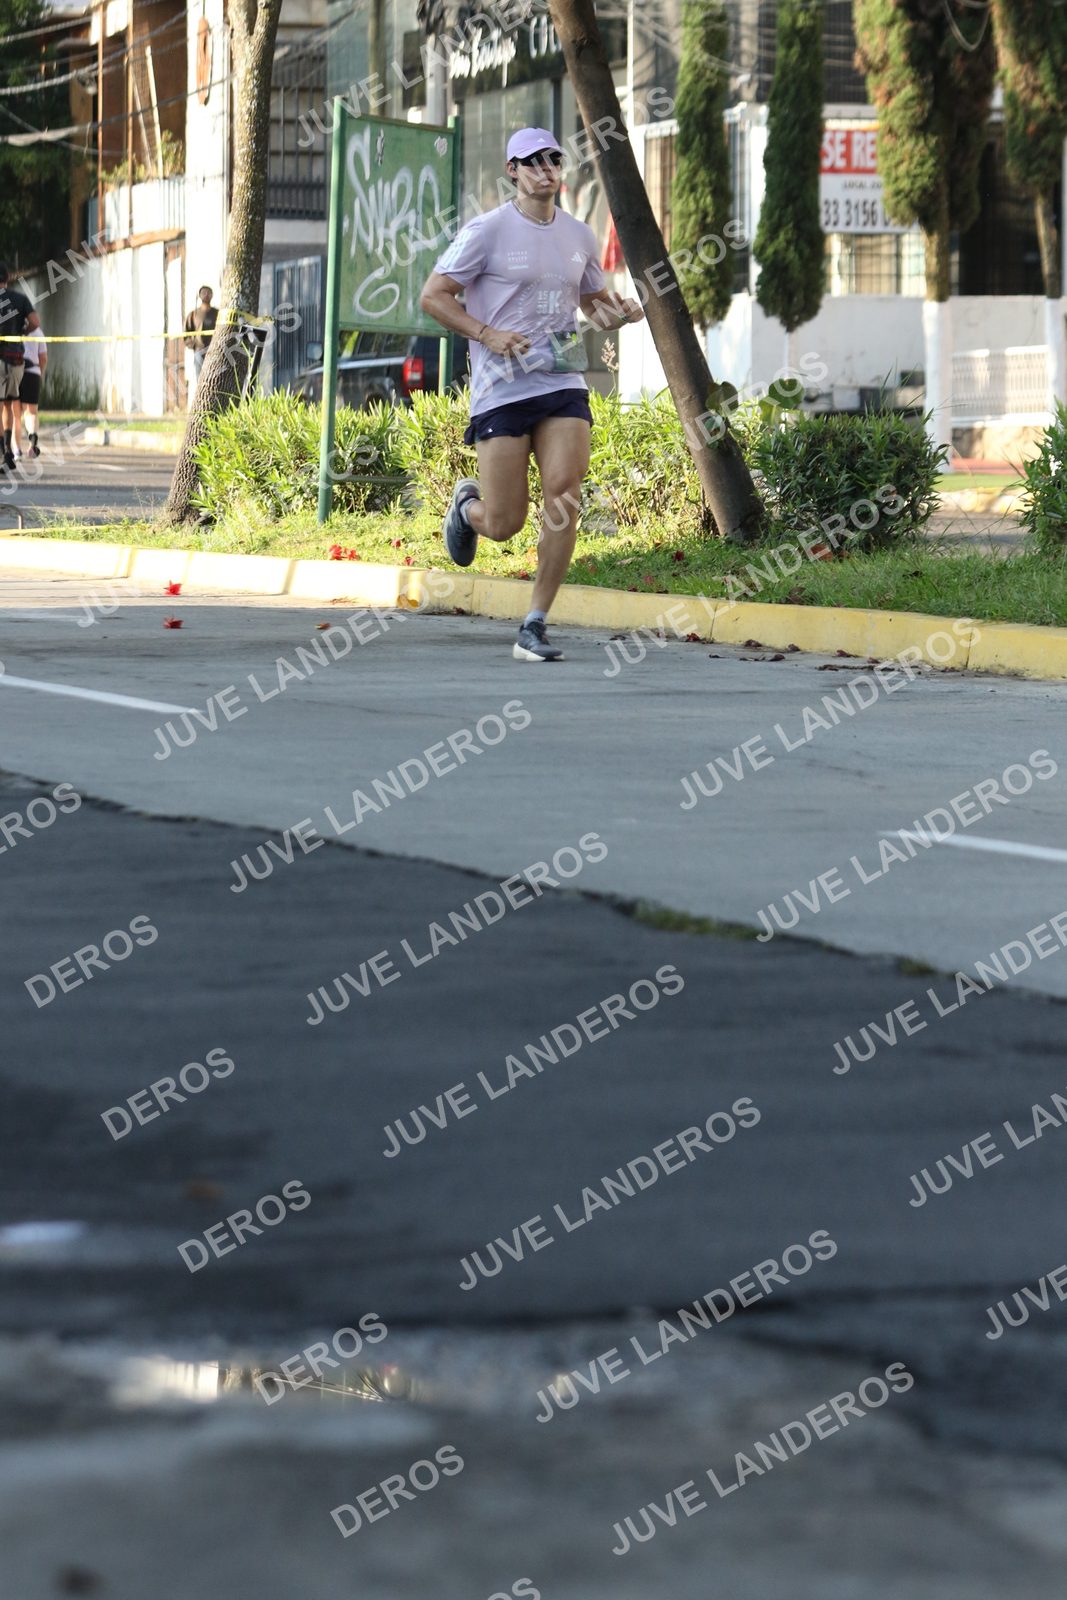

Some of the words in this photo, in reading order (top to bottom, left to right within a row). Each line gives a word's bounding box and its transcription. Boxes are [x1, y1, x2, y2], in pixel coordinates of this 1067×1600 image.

[820, 130, 847, 169] SE
[823, 199, 839, 227] 33
[845, 199, 878, 227] 3156
